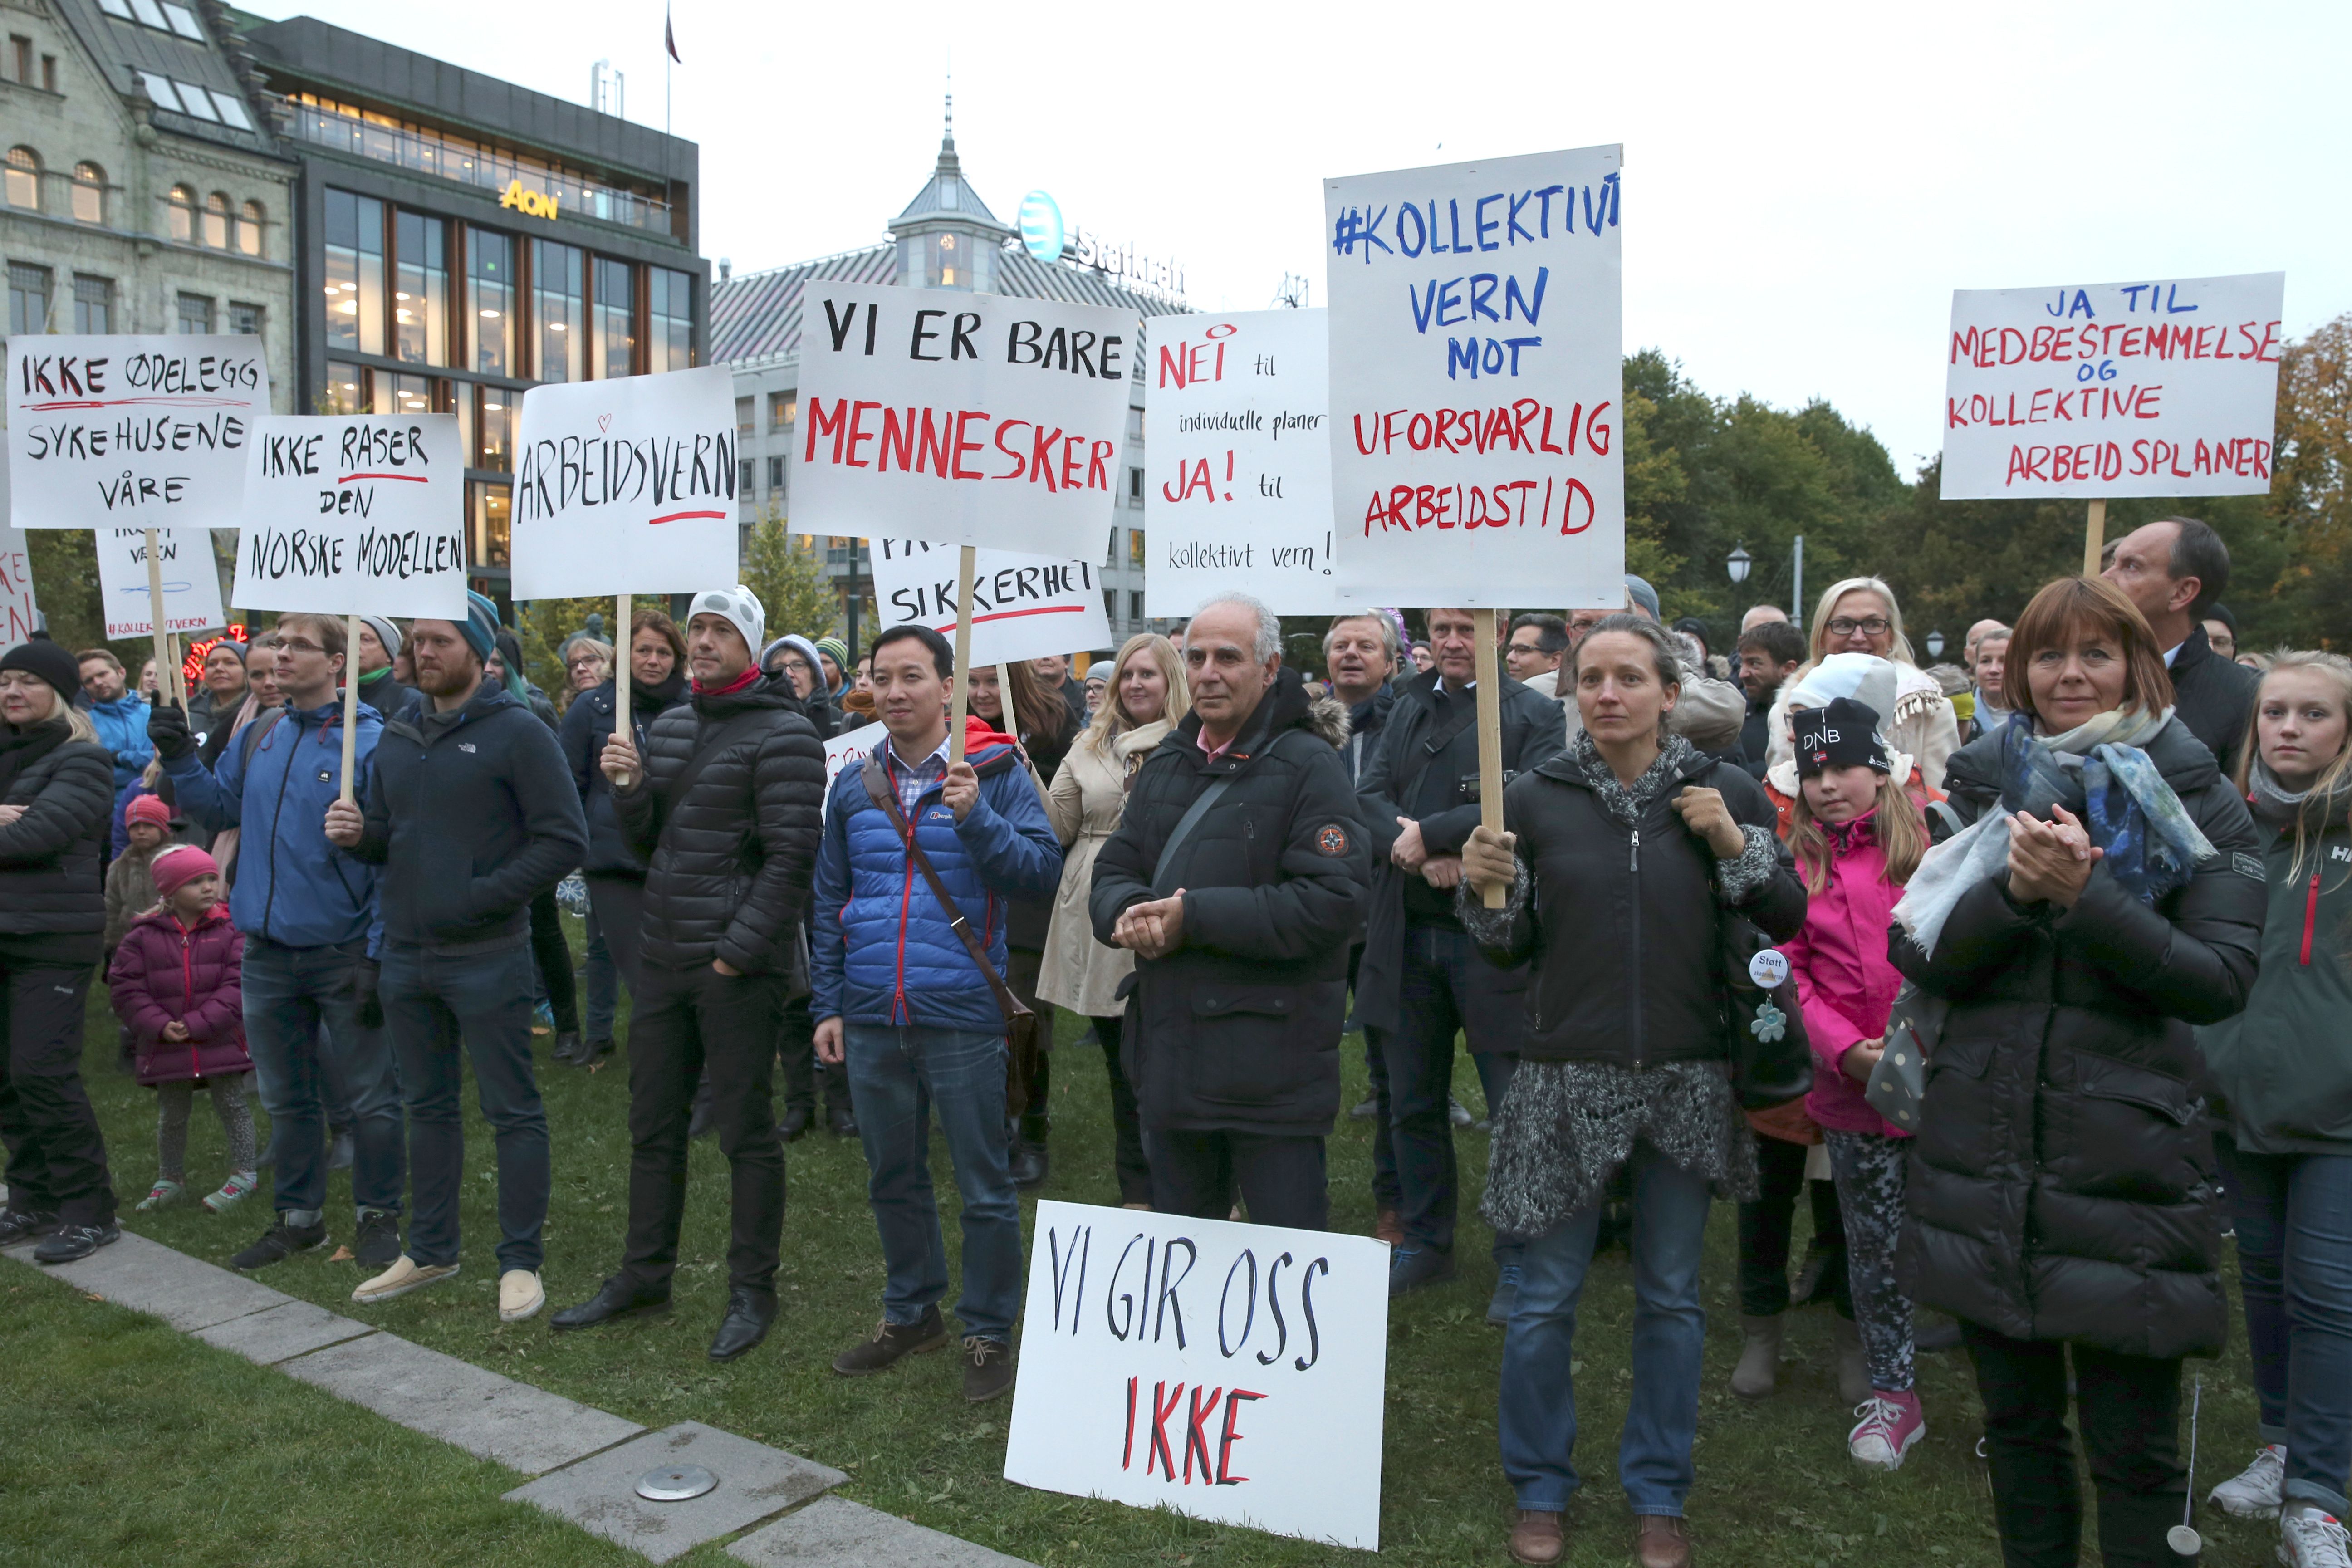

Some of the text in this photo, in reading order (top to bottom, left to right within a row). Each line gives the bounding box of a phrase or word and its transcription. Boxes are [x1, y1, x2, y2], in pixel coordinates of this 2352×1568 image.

[1410, 266, 1549, 334] VERN
[2046, 284, 2198, 318] JA TIL
[823, 299, 1123, 380] VI ER BARE
[1159, 323, 1276, 390] NEI til
[1447, 336, 1542, 380] MOT
[1951, 320, 2282, 368] MEDBESTEMMELSE
[23, 353, 259, 397] IKKE ØDELEGG
[2076, 360, 2117, 382] OG
[1179, 412, 1328, 440] individuelle planer
[1354, 398, 1610, 456] UFORSVARLIG
[1948, 385, 2163, 429] KOLLEKTIVE
[28, 412, 245, 460] SYKEHUSENE
[263, 423, 429, 478] IKKE RASER
[805, 397, 1114, 493] MENNESKER
[517, 428, 736, 524] ARBEIDSVERN
[1162, 450, 1283, 503] JA! til
[2005, 438, 2271, 487] ARBEIDSPLANER
[98, 470, 191, 510] VÅRE
[1364, 476, 1595, 538] ARBEIDSTID
[251, 526, 462, 580] NORSKE MODELLEN
[1169, 542, 1254, 569] kollektivt
[892, 559, 1091, 622] SIKKERHET
[1803, 725, 1841, 751] DNB
[1759, 955, 1781, 967] Støtt
[1049, 1225, 1329, 1372] VI GIR OSS
[1122, 1376, 1269, 1486] IKKE
